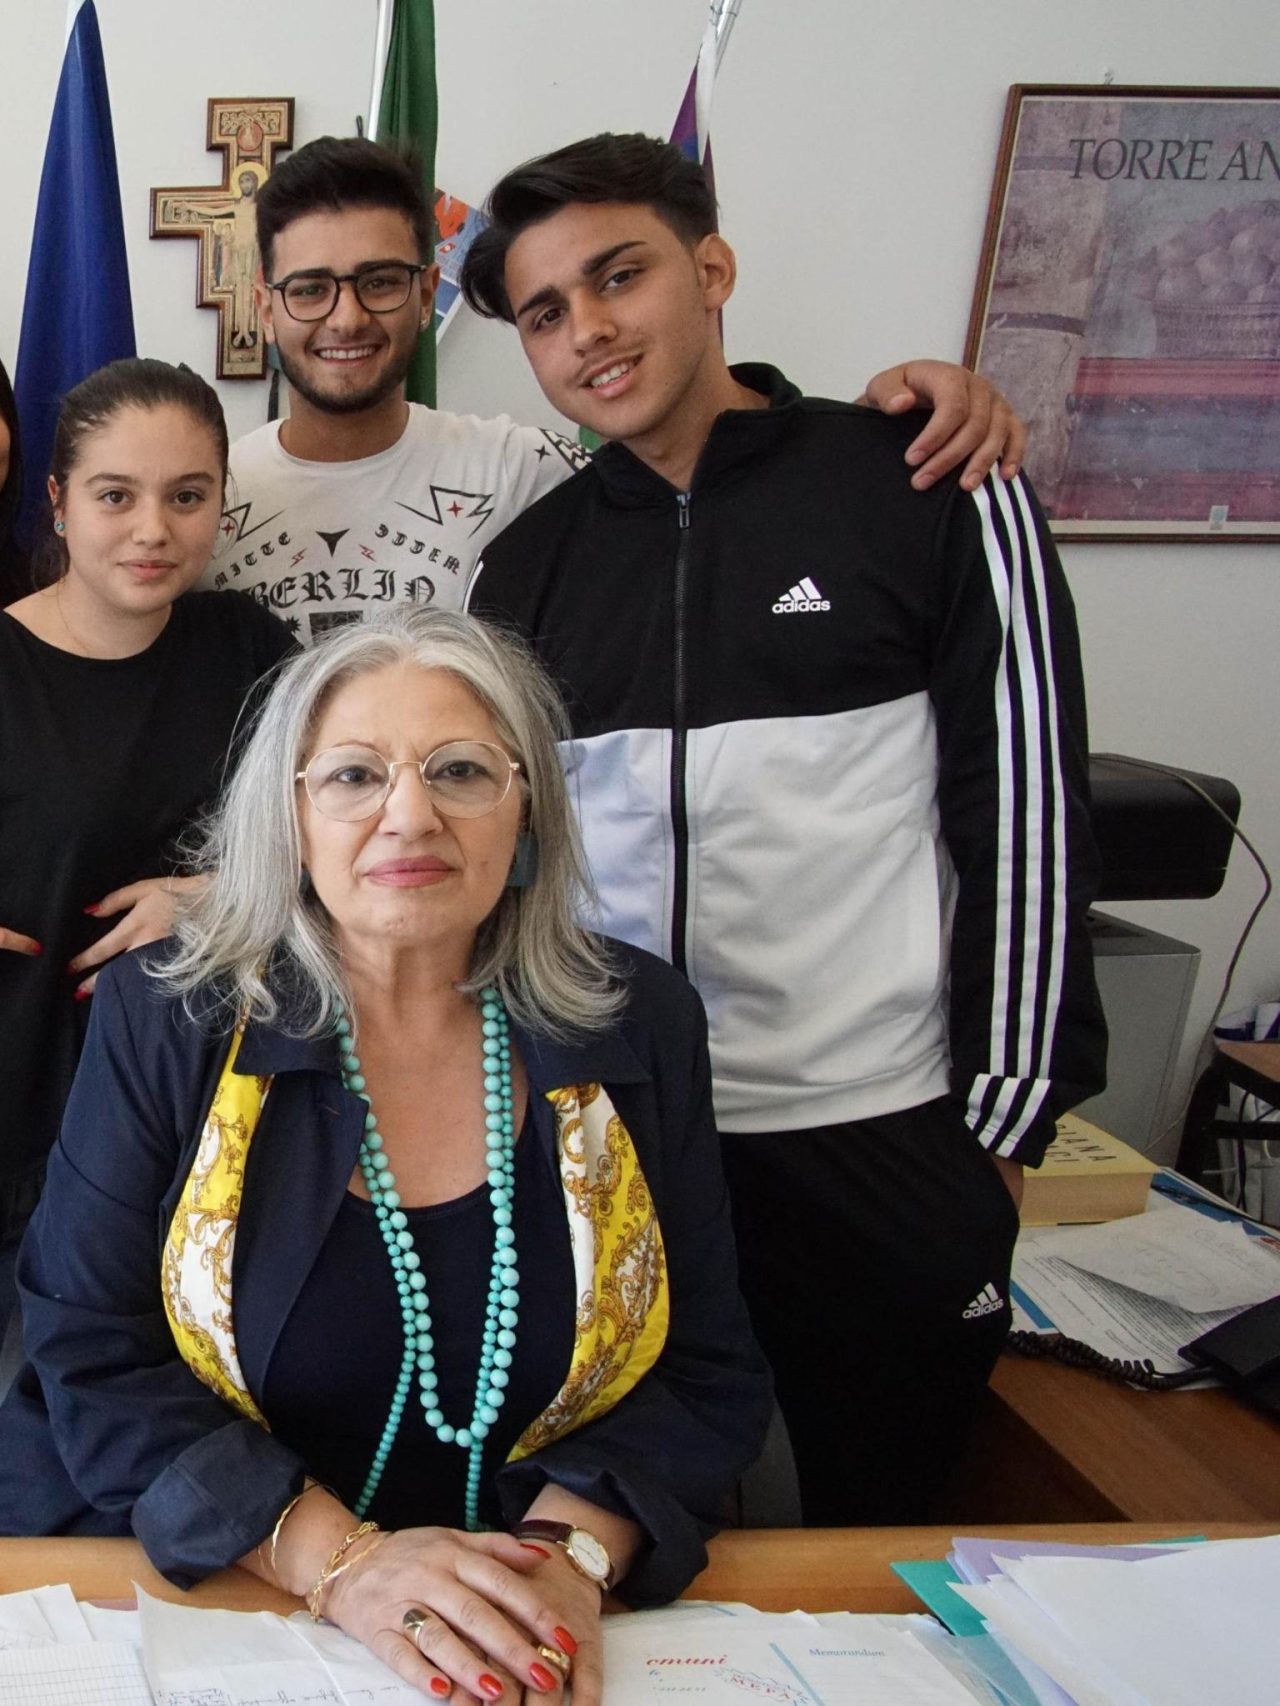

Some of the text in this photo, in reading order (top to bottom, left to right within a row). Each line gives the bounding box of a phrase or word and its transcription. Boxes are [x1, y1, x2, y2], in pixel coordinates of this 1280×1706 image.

[1070, 138, 1213, 180] TORRE
[245, 568, 436, 609] BERLIN
[772, 599, 831, 614] adidas
[962, 1299, 1004, 1319] adidas
